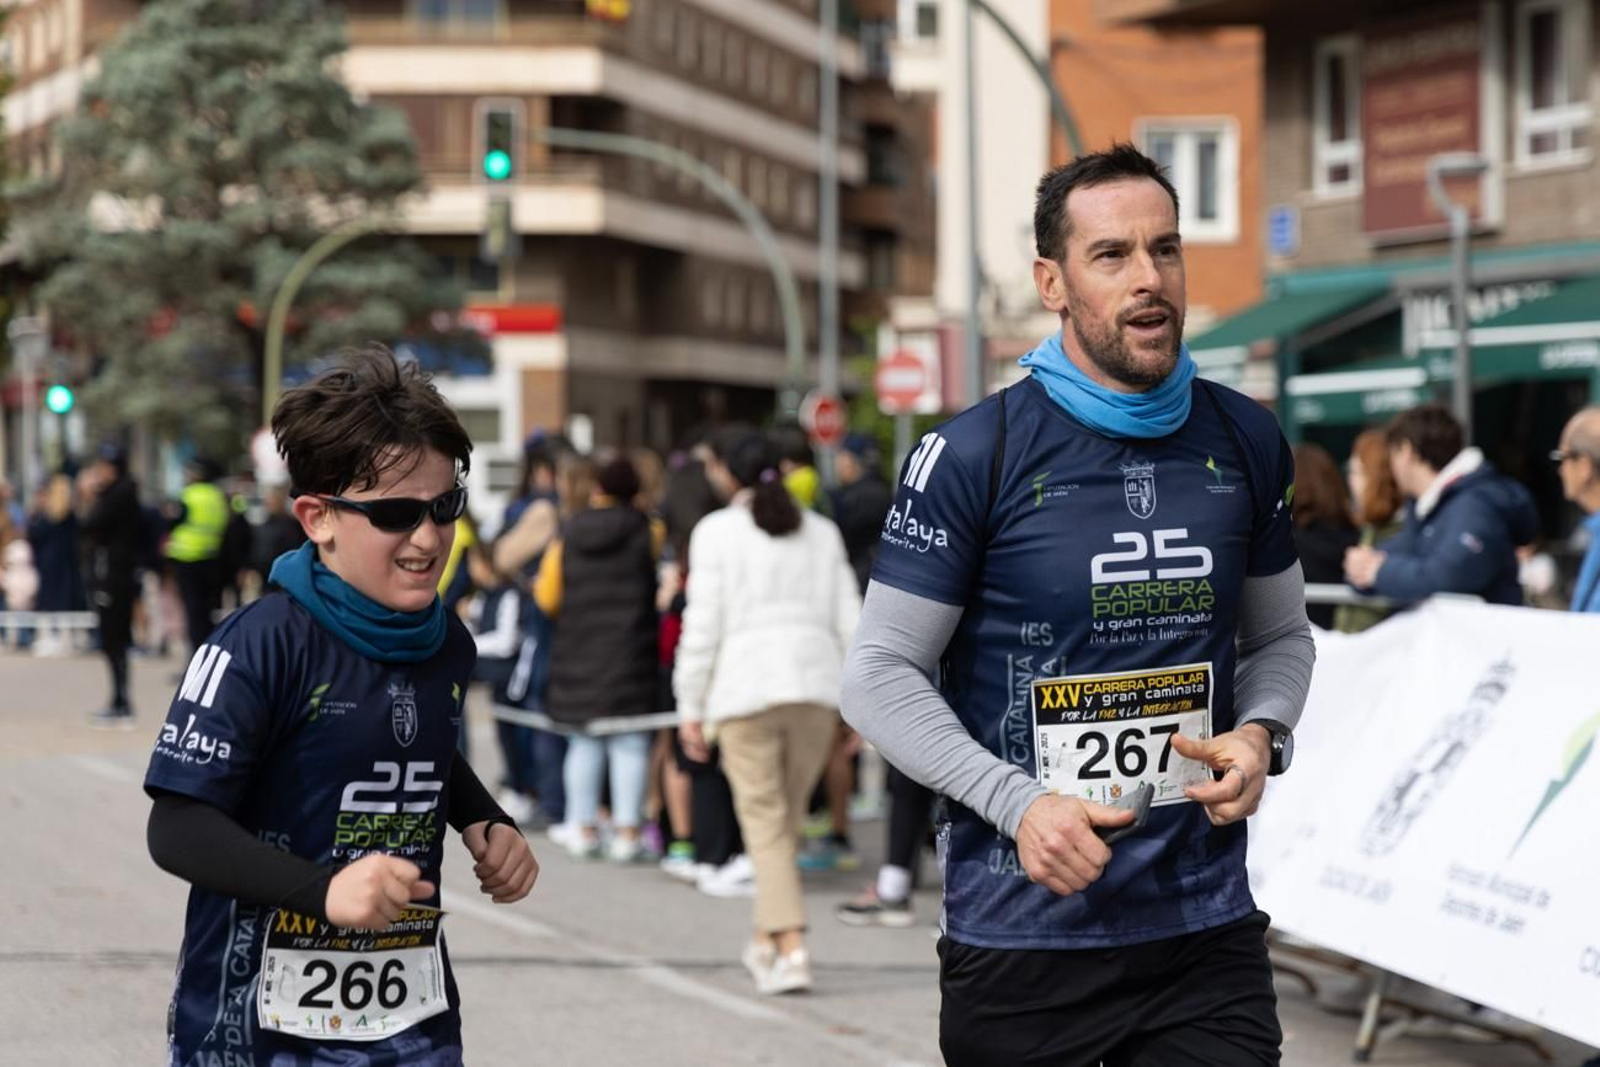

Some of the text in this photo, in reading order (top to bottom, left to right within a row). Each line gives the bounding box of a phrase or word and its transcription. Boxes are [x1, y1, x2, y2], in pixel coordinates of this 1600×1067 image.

[1090, 528, 1213, 584] 25
[1091, 579, 1214, 601] CARRERA
[1092, 595, 1216, 618] POPULAR
[1020, 621, 1054, 647] IES
[1093, 612, 1213, 632] y gran caminata
[1040, 684, 1081, 709] XXV
[1083, 672, 1205, 696] CARRERA POPULAR
[1084, 682, 1205, 708] y gran caminata
[1009, 655, 1034, 764] CATALINA
[1060, 710, 1080, 722] POR
[1082, 710, 1098, 721] LA
[1126, 706, 1141, 717] LA
[161, 713, 231, 764] alaya
[1075, 722, 1180, 780] 267
[339, 761, 443, 814] 25
[275, 909, 316, 933] XXV
[297, 958, 408, 1011] 266
